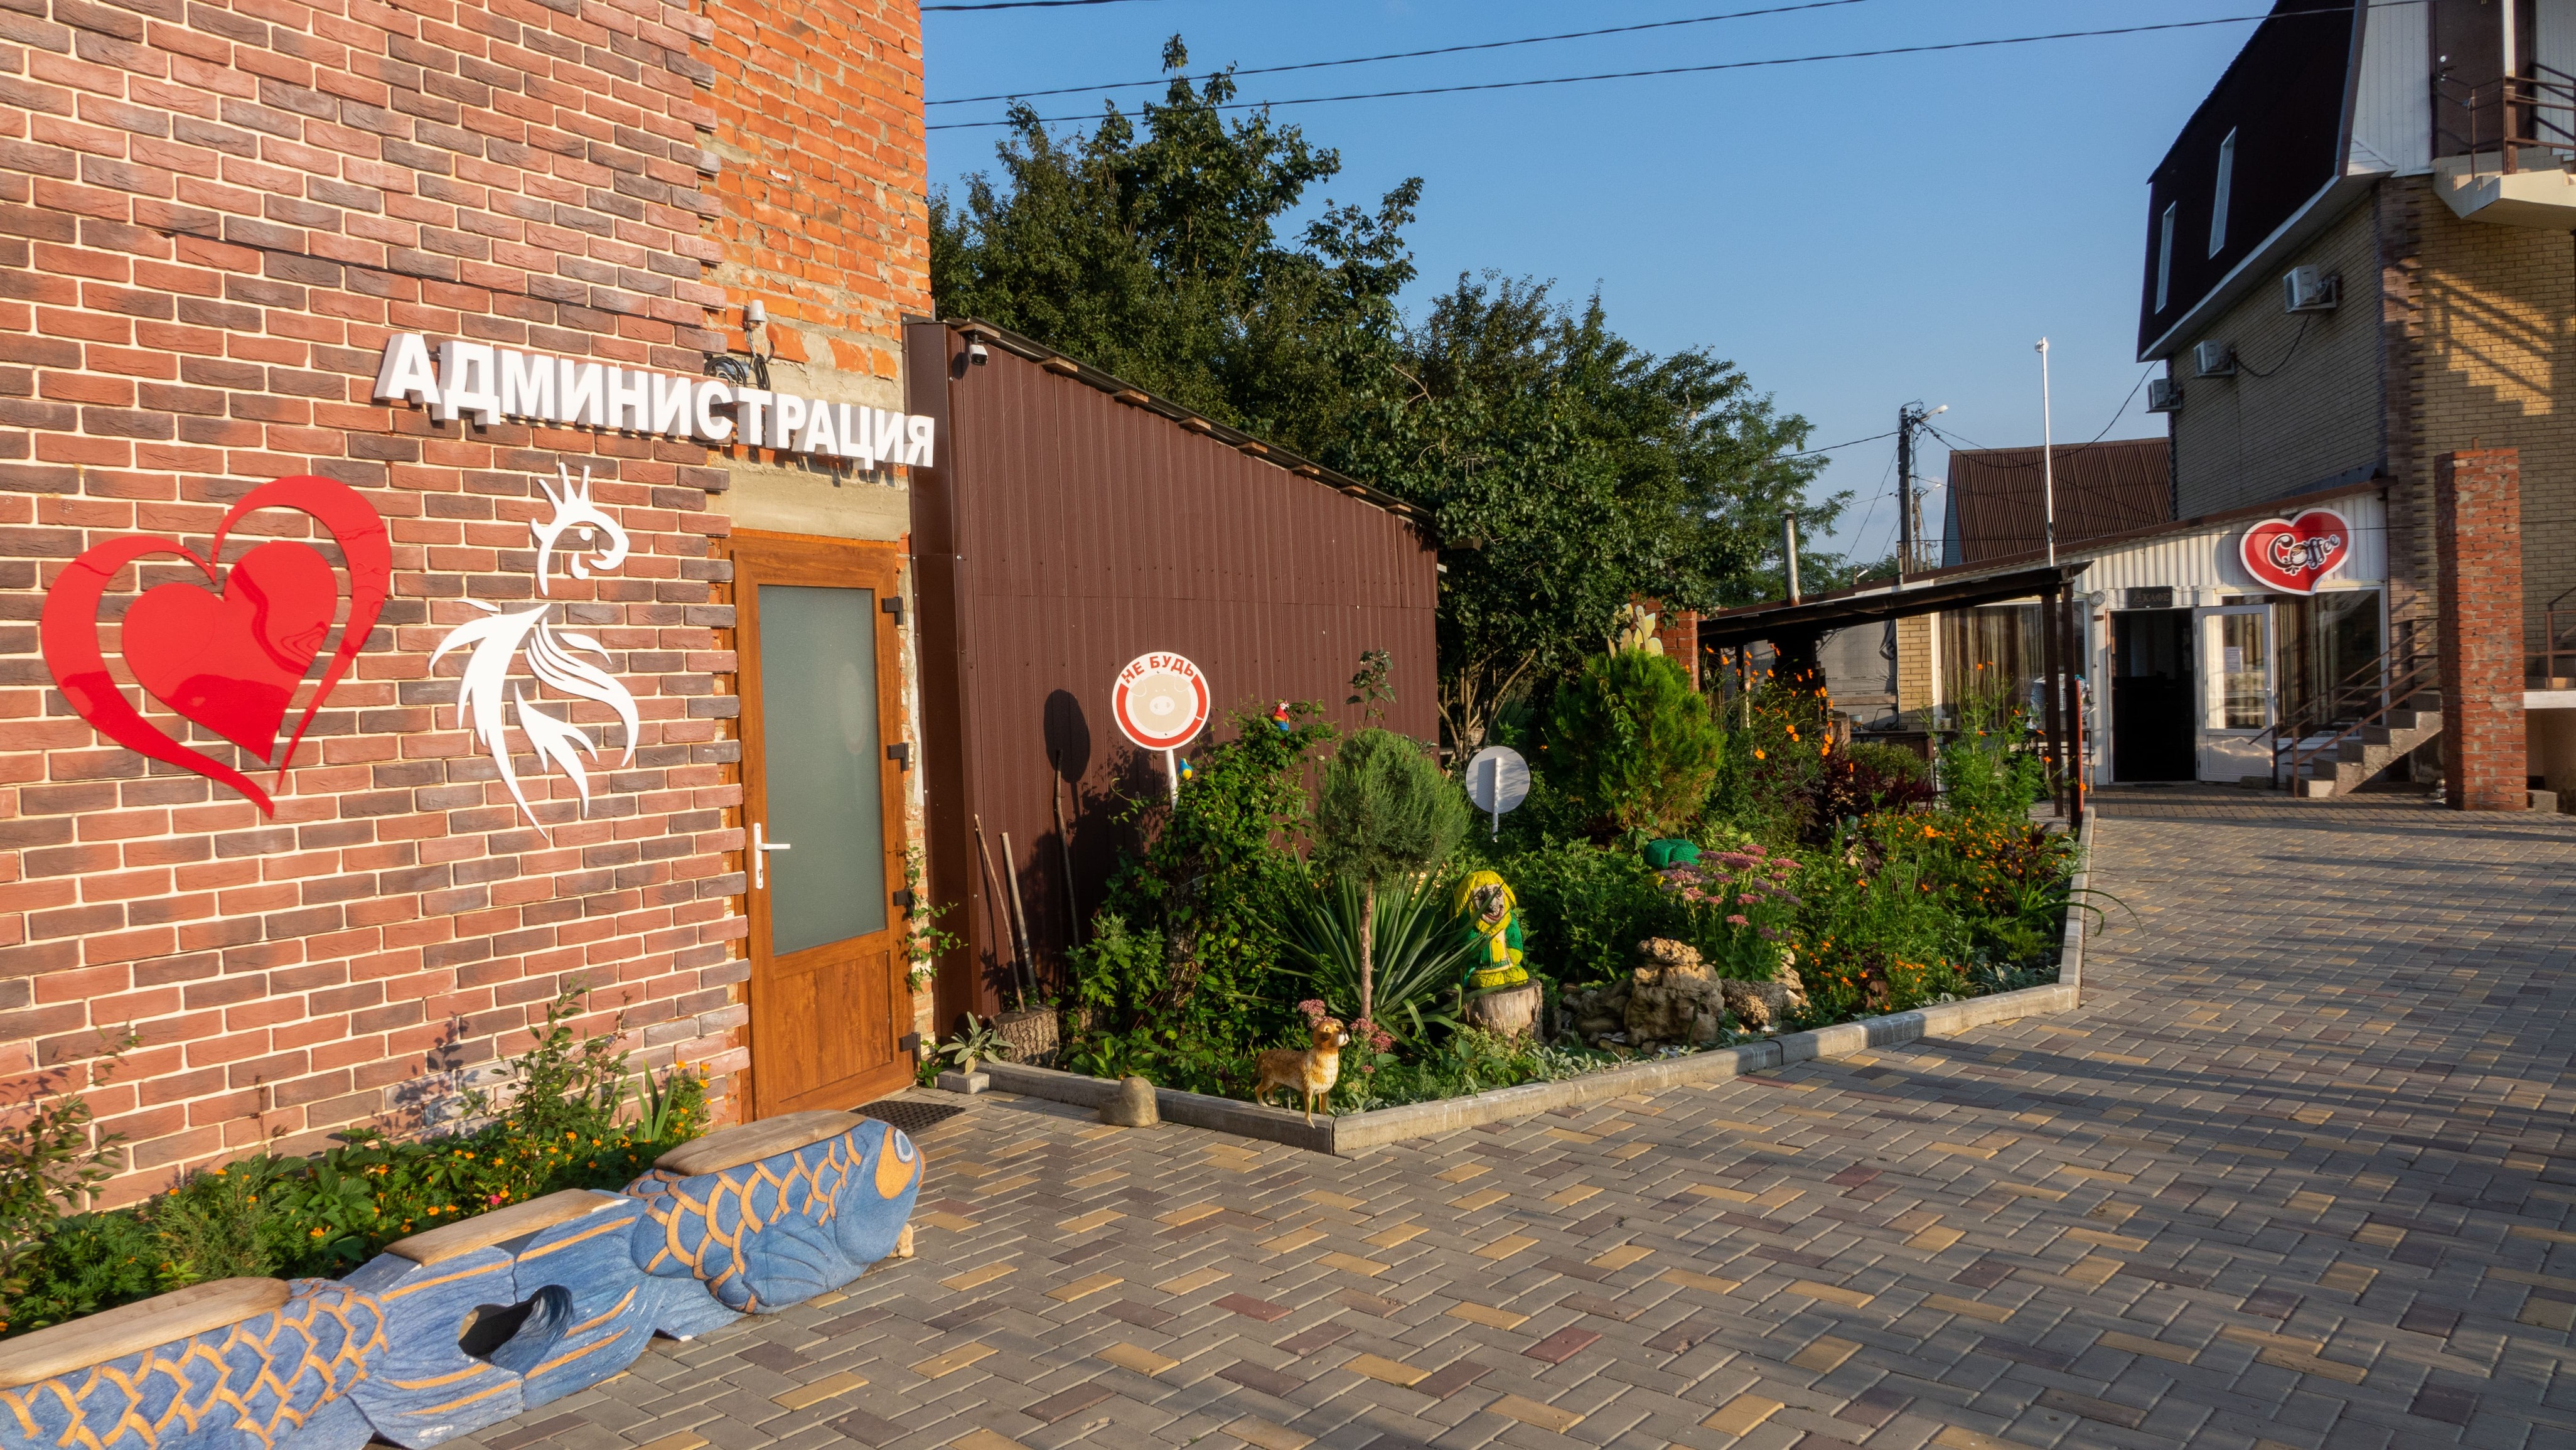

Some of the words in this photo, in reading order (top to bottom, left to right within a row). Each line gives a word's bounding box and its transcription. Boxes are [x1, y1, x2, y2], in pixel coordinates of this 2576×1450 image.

[375, 333, 935, 470] АДМИНИСТРАЦИЯ
[2268, 534, 2341, 570] Coffee
[1121, 662, 1145, 684] НЕ
[1149, 655, 1194, 677] БУДЬ
